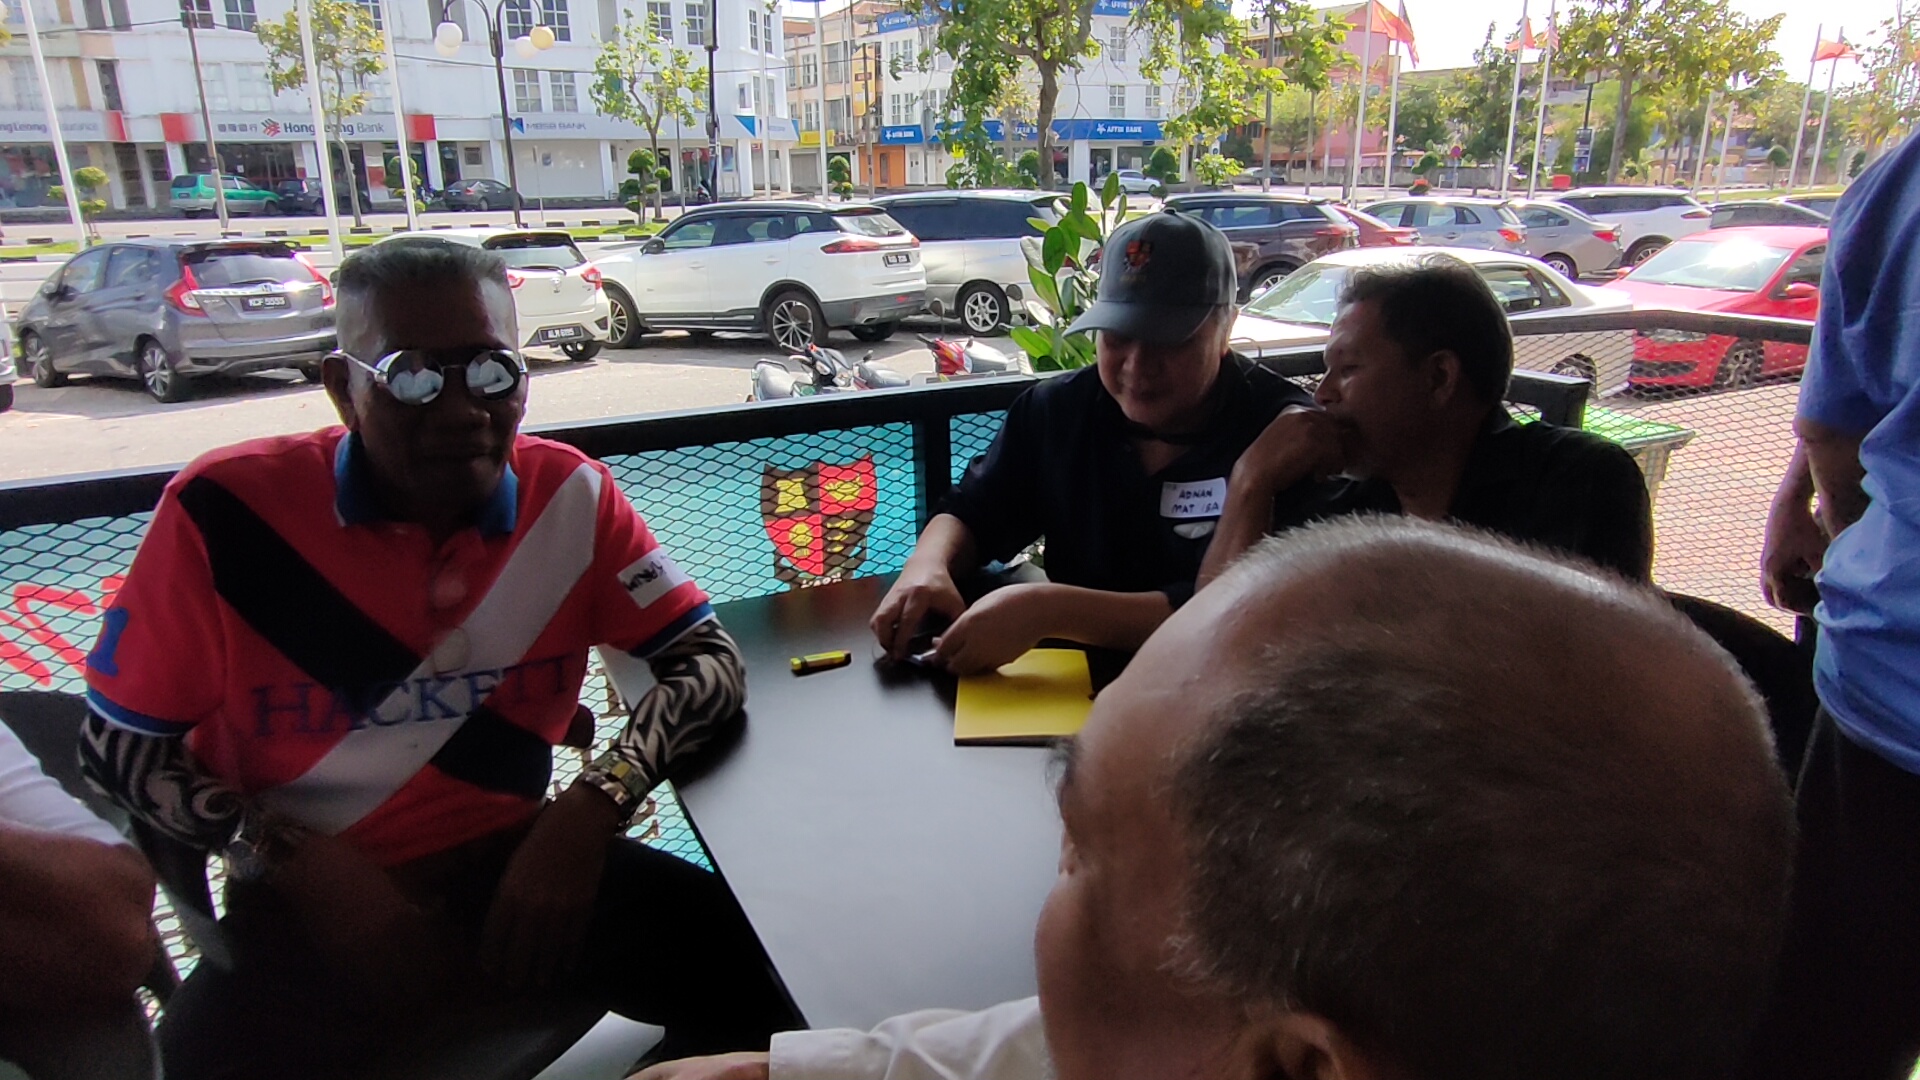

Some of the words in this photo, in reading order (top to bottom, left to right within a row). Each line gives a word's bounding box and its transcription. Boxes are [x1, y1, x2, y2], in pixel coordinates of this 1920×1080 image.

[357, 122, 384, 133] Bank
[559, 122, 586, 130] BANK
[1179, 488, 1213, 499] ADNAN
[1171, 503, 1195, 514] MAT
[253, 654, 572, 737] HACKETT
